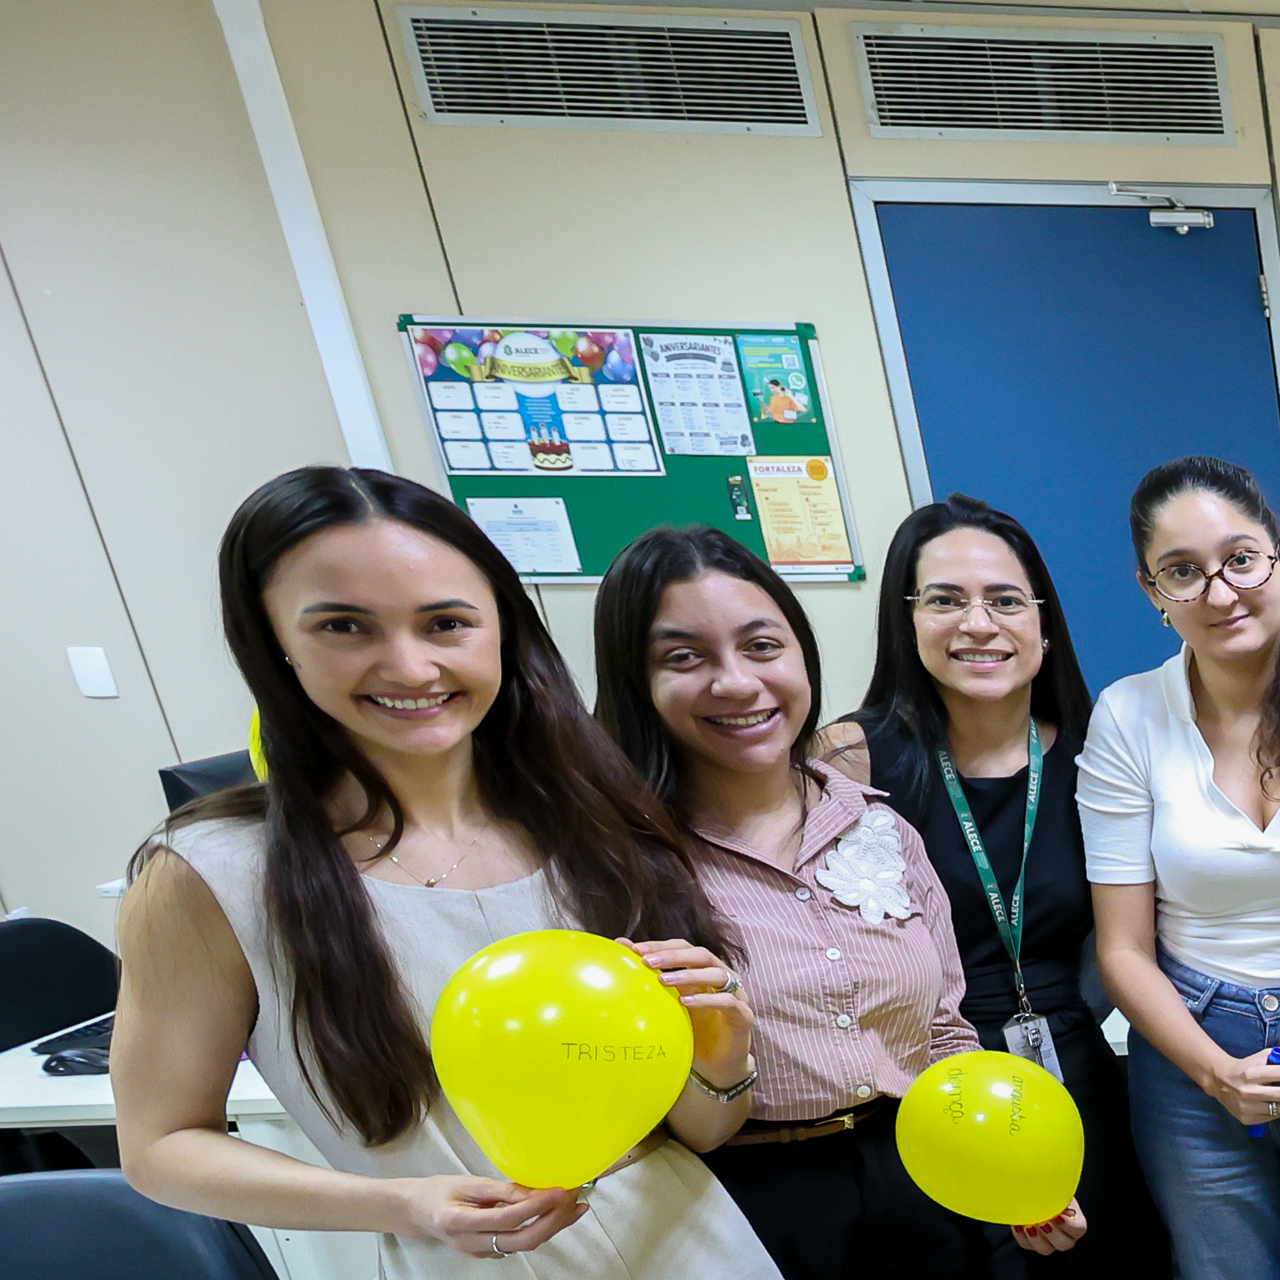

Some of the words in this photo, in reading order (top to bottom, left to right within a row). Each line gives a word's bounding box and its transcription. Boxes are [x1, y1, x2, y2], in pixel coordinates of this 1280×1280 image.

[754, 465, 802, 473] FORTALEZA
[1028, 771, 1039, 803] ALECE
[962, 821, 983, 853] ALECE
[988, 892, 1006, 923] ALECE
[1011, 894, 1020, 926] ALECE
[560, 1042, 666, 1062] TRISTEZA
